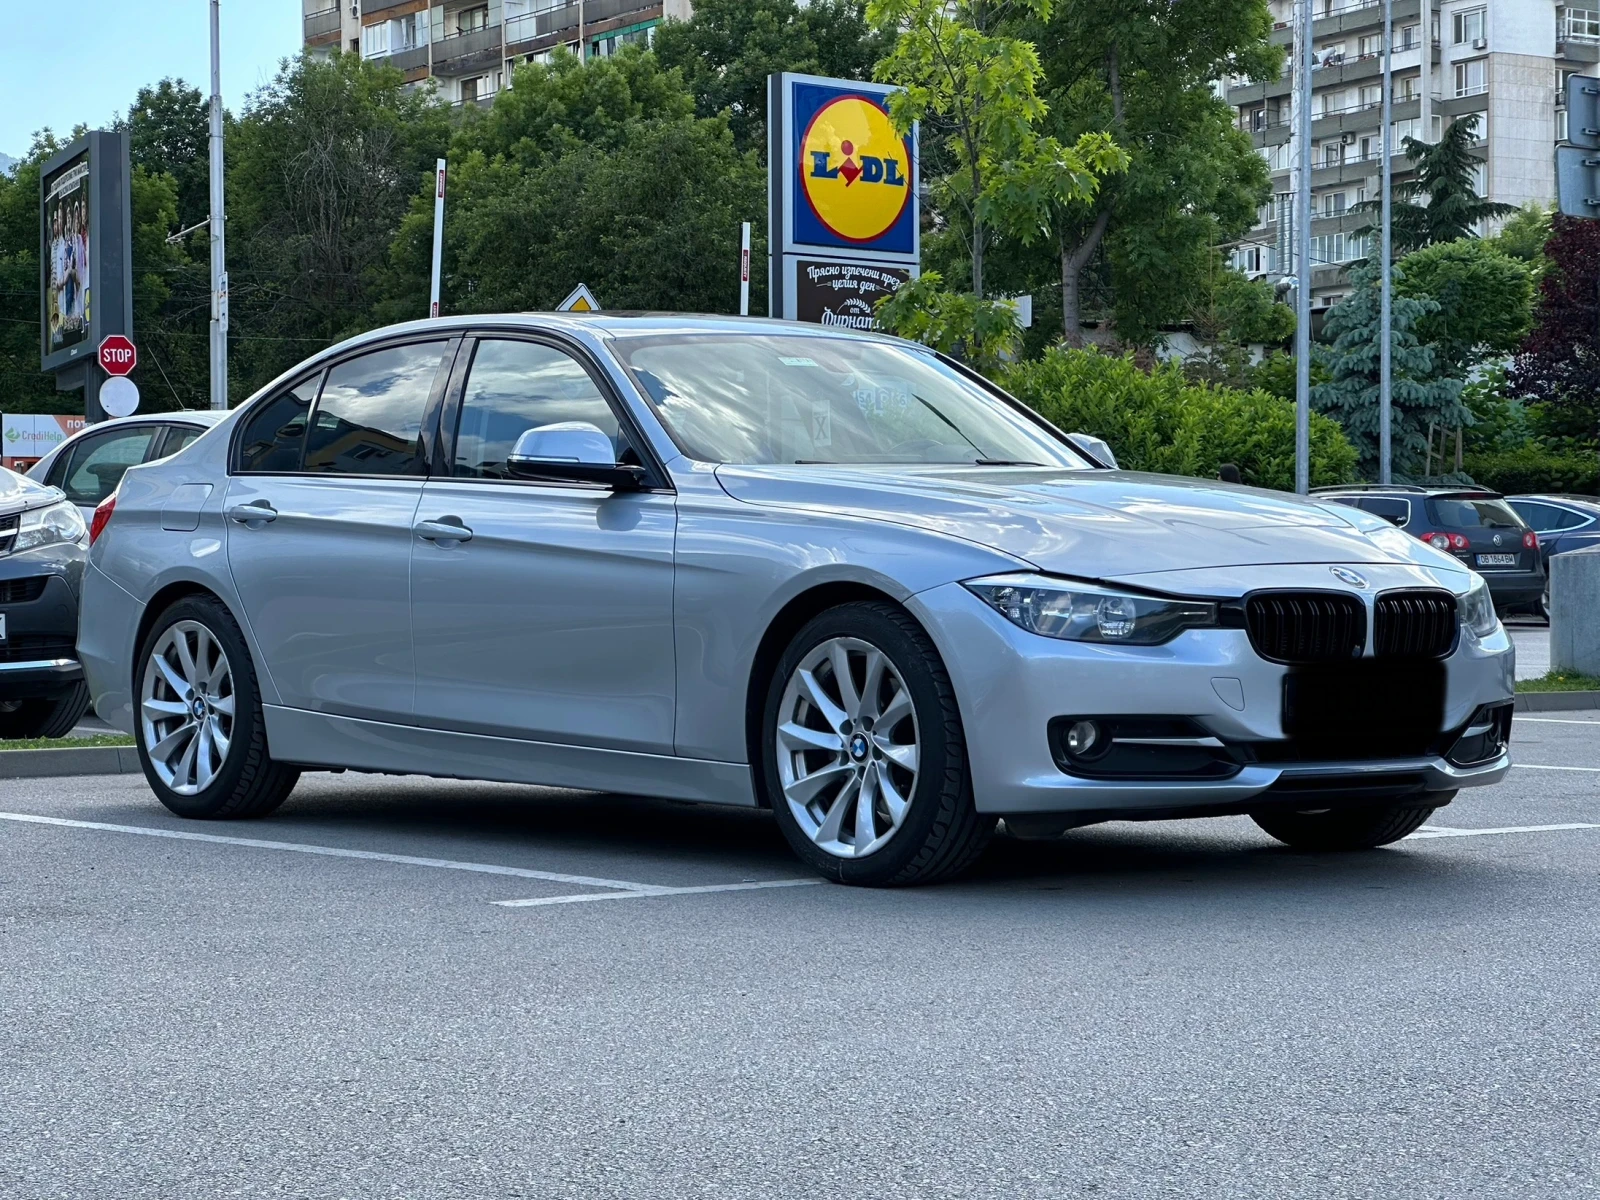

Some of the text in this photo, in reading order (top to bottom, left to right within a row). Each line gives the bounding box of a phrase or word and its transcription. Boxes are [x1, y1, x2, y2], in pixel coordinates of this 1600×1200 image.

[807, 265, 901, 290] Прясно изпечени през
[832, 279, 876, 294] целия ден
[103, 348, 132, 363] STOP
[21, 430, 62, 443] CrediHelp
